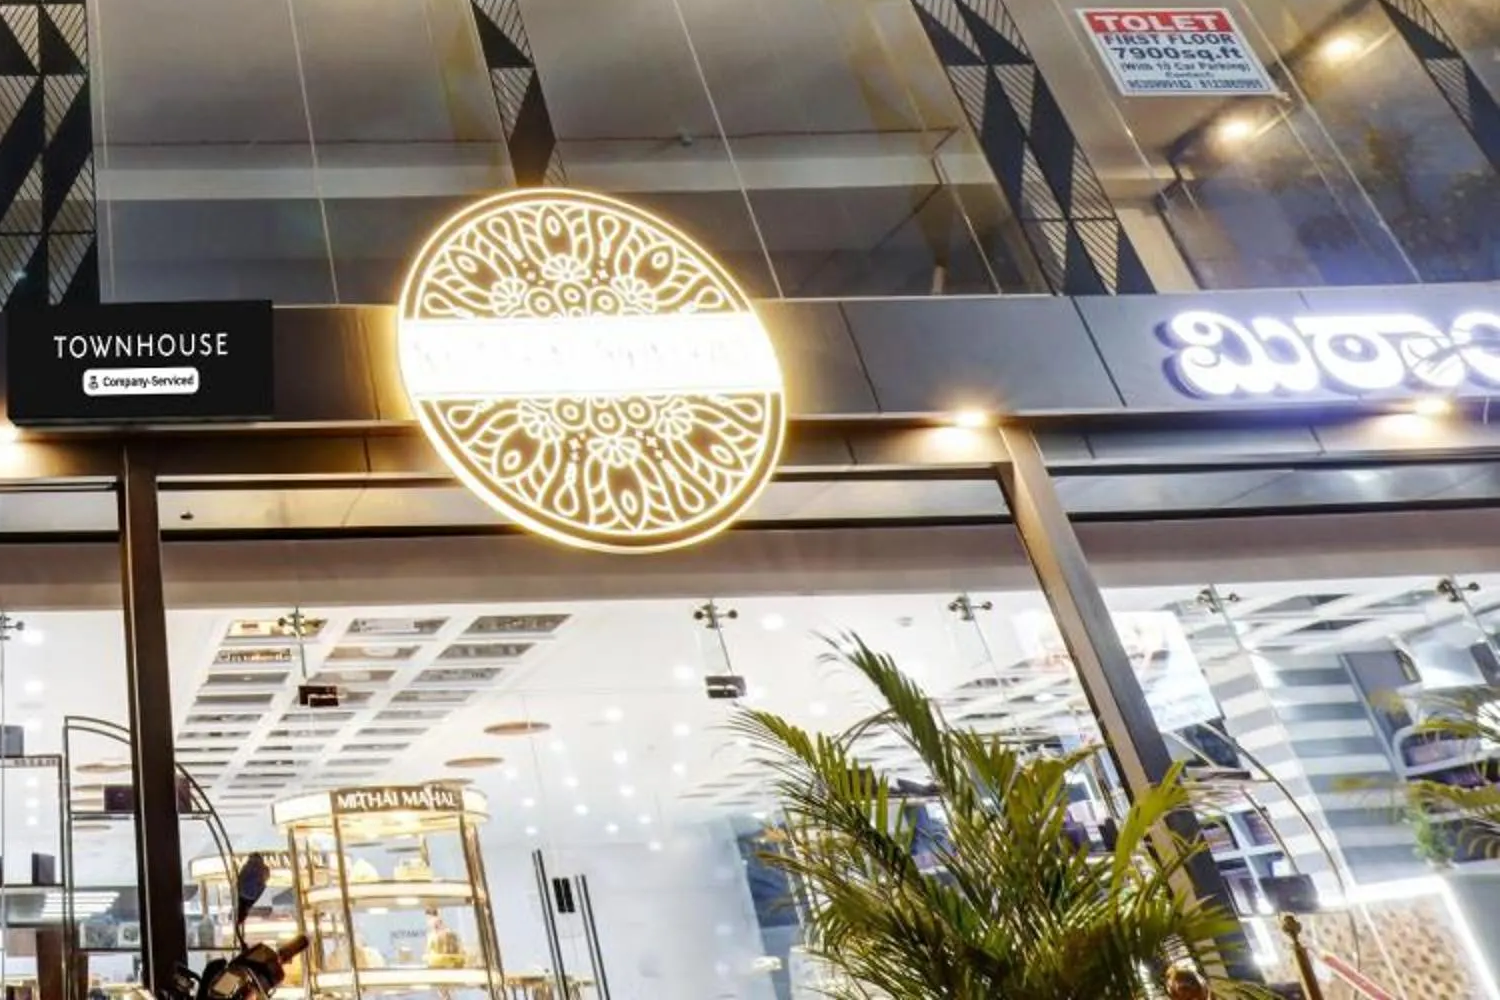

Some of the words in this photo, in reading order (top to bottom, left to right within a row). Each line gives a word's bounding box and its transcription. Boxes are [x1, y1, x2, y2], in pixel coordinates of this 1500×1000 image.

[1103, 33, 1159, 45] FIRST
[1168, 33, 1237, 45] FLOOR
[1110, 47, 1244, 62] 7900sq.ft
[1121, 63, 1153, 73] (With
[1174, 63, 1196, 71] Car
[1200, 62, 1251, 73] Parking)
[53, 332, 229, 359] TOWNHOUSE
[102, 374, 195, 389] Company-Serviced
[337, 790, 399, 811] MITHAI
[402, 787, 457, 808] MAHAL
